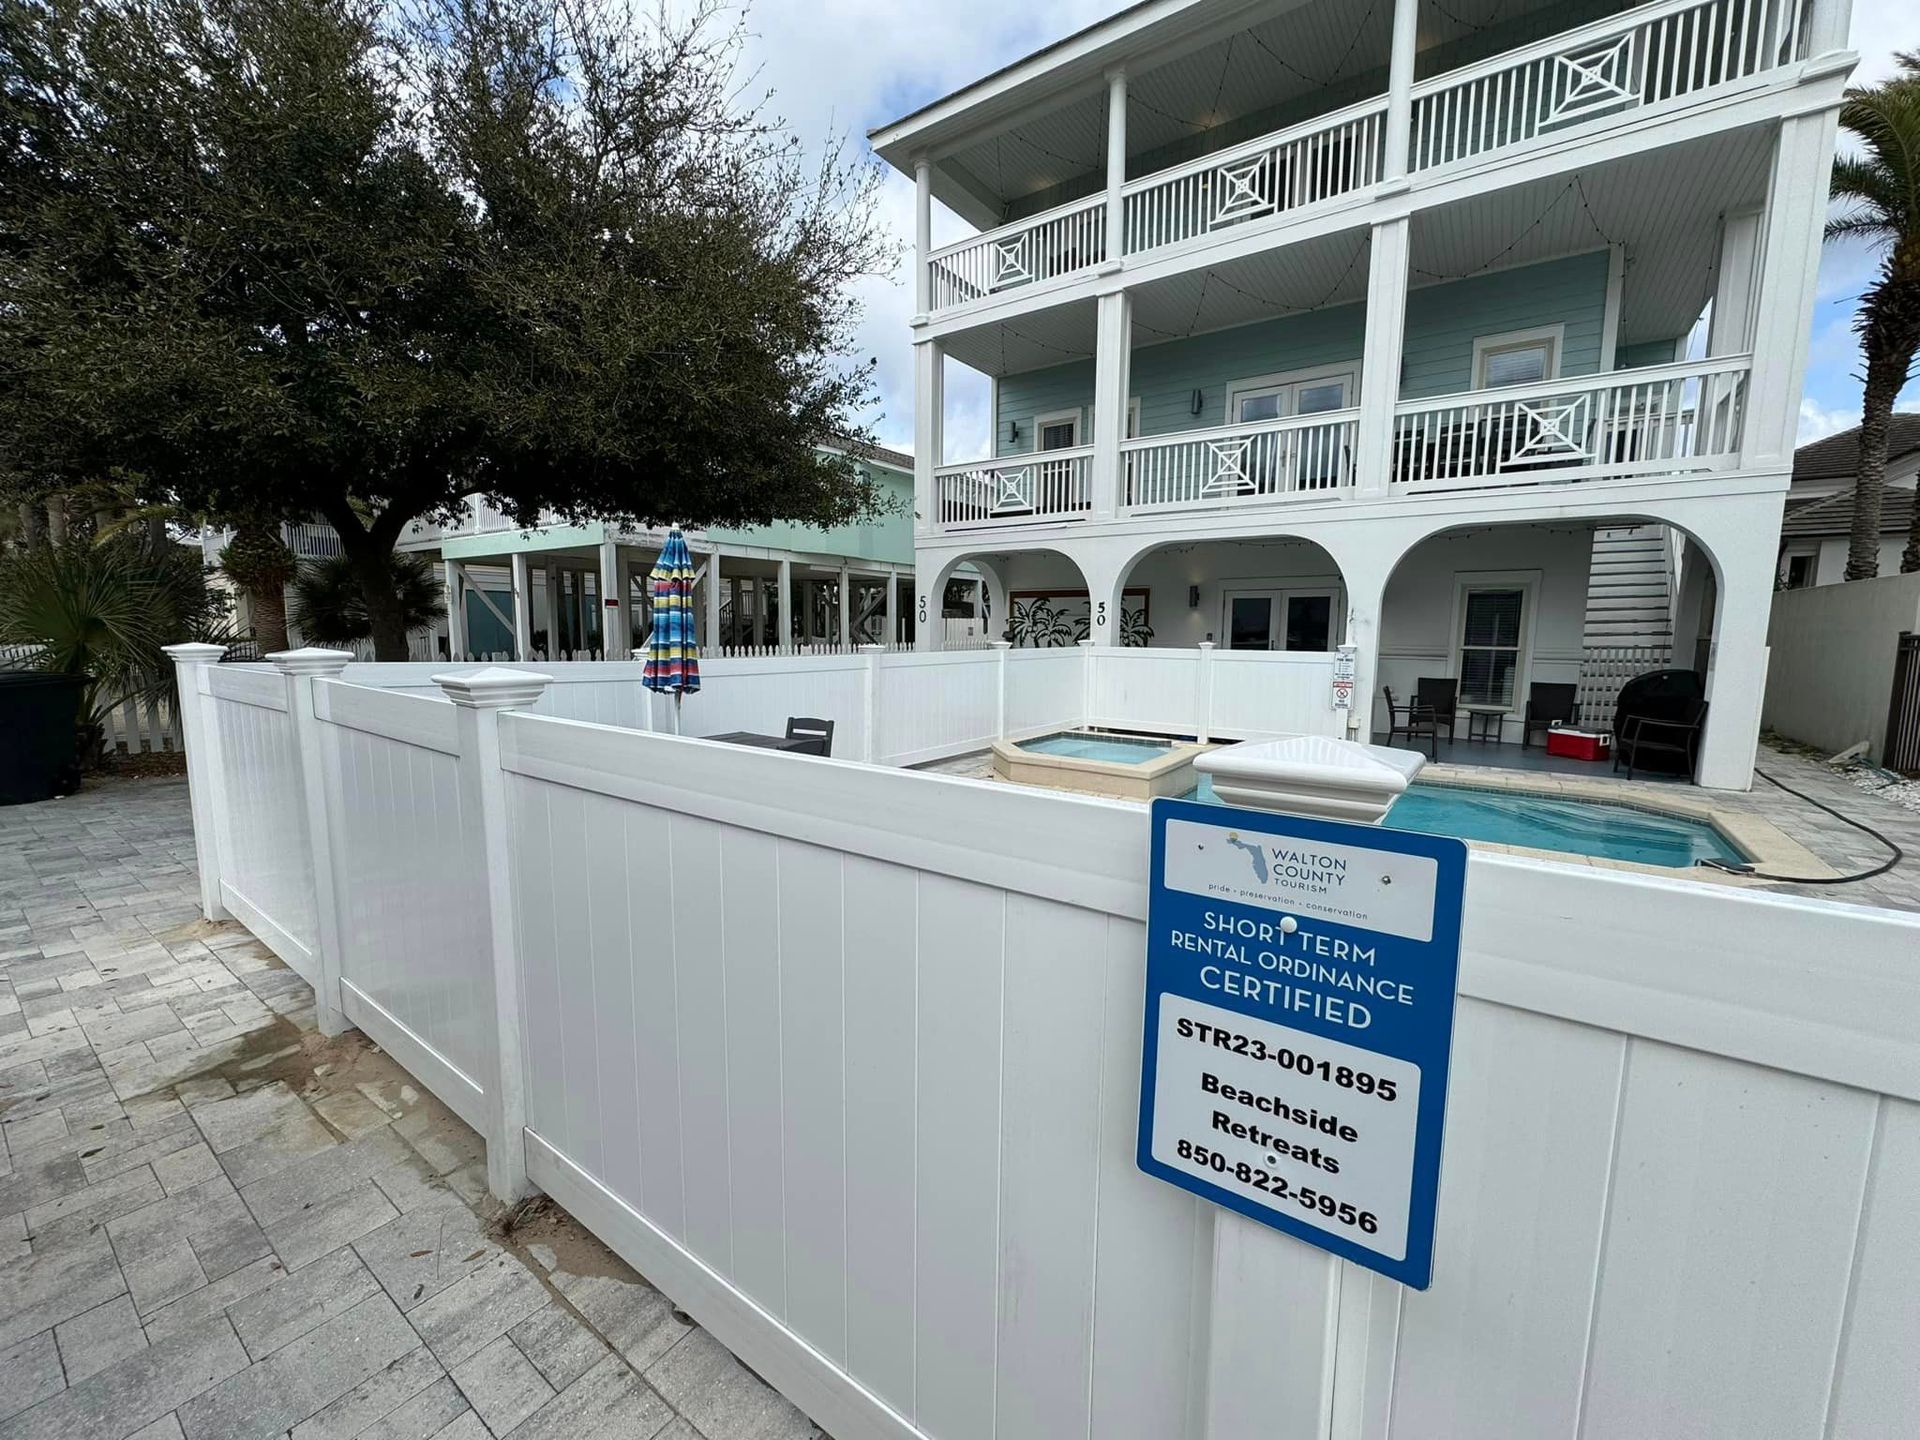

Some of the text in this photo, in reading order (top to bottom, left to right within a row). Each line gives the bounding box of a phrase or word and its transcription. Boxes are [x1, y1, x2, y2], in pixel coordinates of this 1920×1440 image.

[1271, 848, 1347, 871] WALTON
[1272, 863, 1346, 886] COUNTY
[1274, 878, 1327, 895] TOURISM
[1208, 883, 1368, 920] pride preservation conservation
[1171, 930, 1414, 1006] RENTAL ORDINANCE
[1203, 911, 1376, 967] SHORT TERM
[1200, 966, 1372, 1029] CERTIFIED
[1177, 1018, 1397, 1101] STR23-001895
[1201, 1072, 1358, 1143] Beachside
[1212, 1110, 1340, 1174] Retreats
[1177, 1139, 1378, 1234] 850-822-5956
